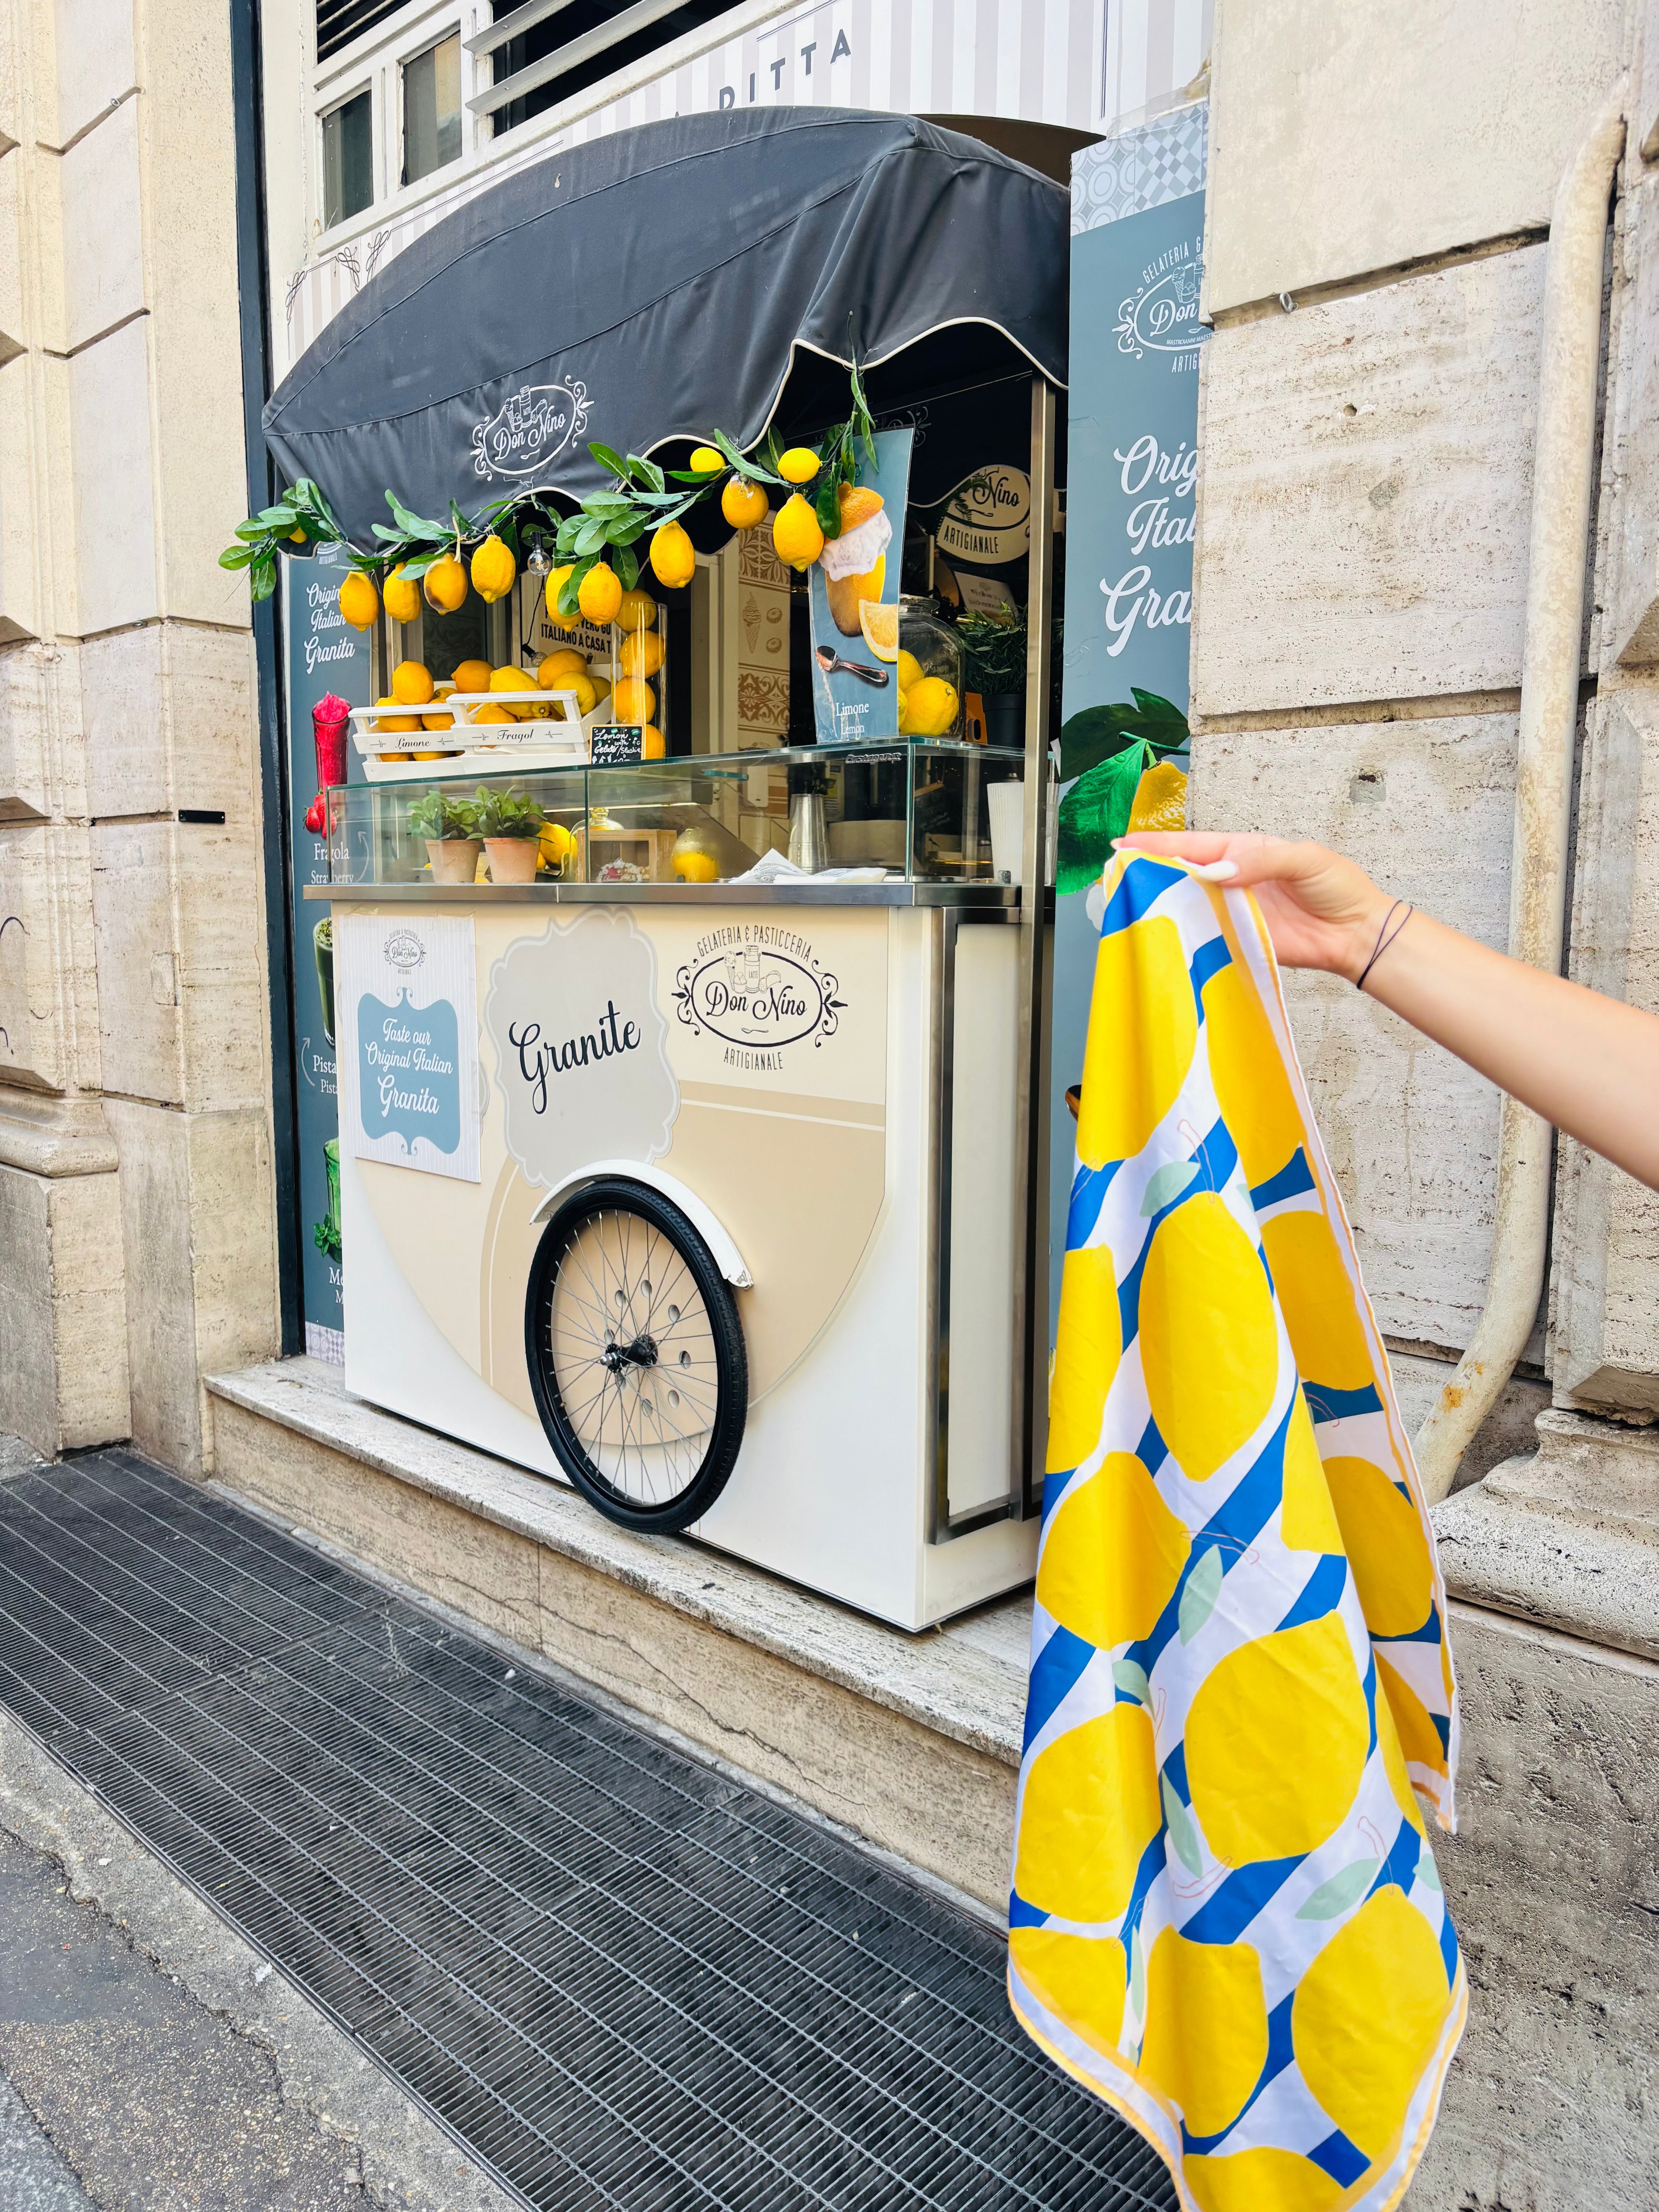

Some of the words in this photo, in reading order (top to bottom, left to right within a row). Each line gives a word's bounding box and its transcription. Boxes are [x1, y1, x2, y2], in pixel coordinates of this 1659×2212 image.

[719, 29, 852, 109] DITTA
[1142, 242, 1189, 284] GELATERIA
[1195, 236, 1201, 253] &
[1149, 299, 1198, 337] Don
[493, 427, 526, 461] Don
[528, 405, 566, 447] Nino
[973, 476, 1020, 509] Nino
[944, 525, 999, 554] ARTIGIANALE
[311, 608, 346, 632] Italian
[541, 623, 576, 645] ITALIANO
[578, 633, 584, 647] A
[585, 635, 605, 652] CASA
[304, 636, 356, 674] Granita
[836, 703, 869, 716] Limone
[395, 737, 431, 750] Limone
[497, 728, 534, 743] Fragol
[594, 729, 628, 741] Lemon
[841, 724, 865, 735] Lemon
[697, 925, 742, 957] GELATERIA
[745, 925, 750, 942] &
[754, 925, 812, 963] PASTICCERIA
[705, 981, 749, 1017] Don
[752, 985, 807, 1021] Nino
[382, 1017, 410, 1042] Taste
[413, 1030, 432, 1046] our
[365, 1042, 410, 1073] Original
[413, 1048, 453, 1074] Italian
[509, 1000, 641, 1114] Granite
[724, 1047, 783, 1070] ARTIGIANALE
[378, 1074, 440, 1118] Granita
